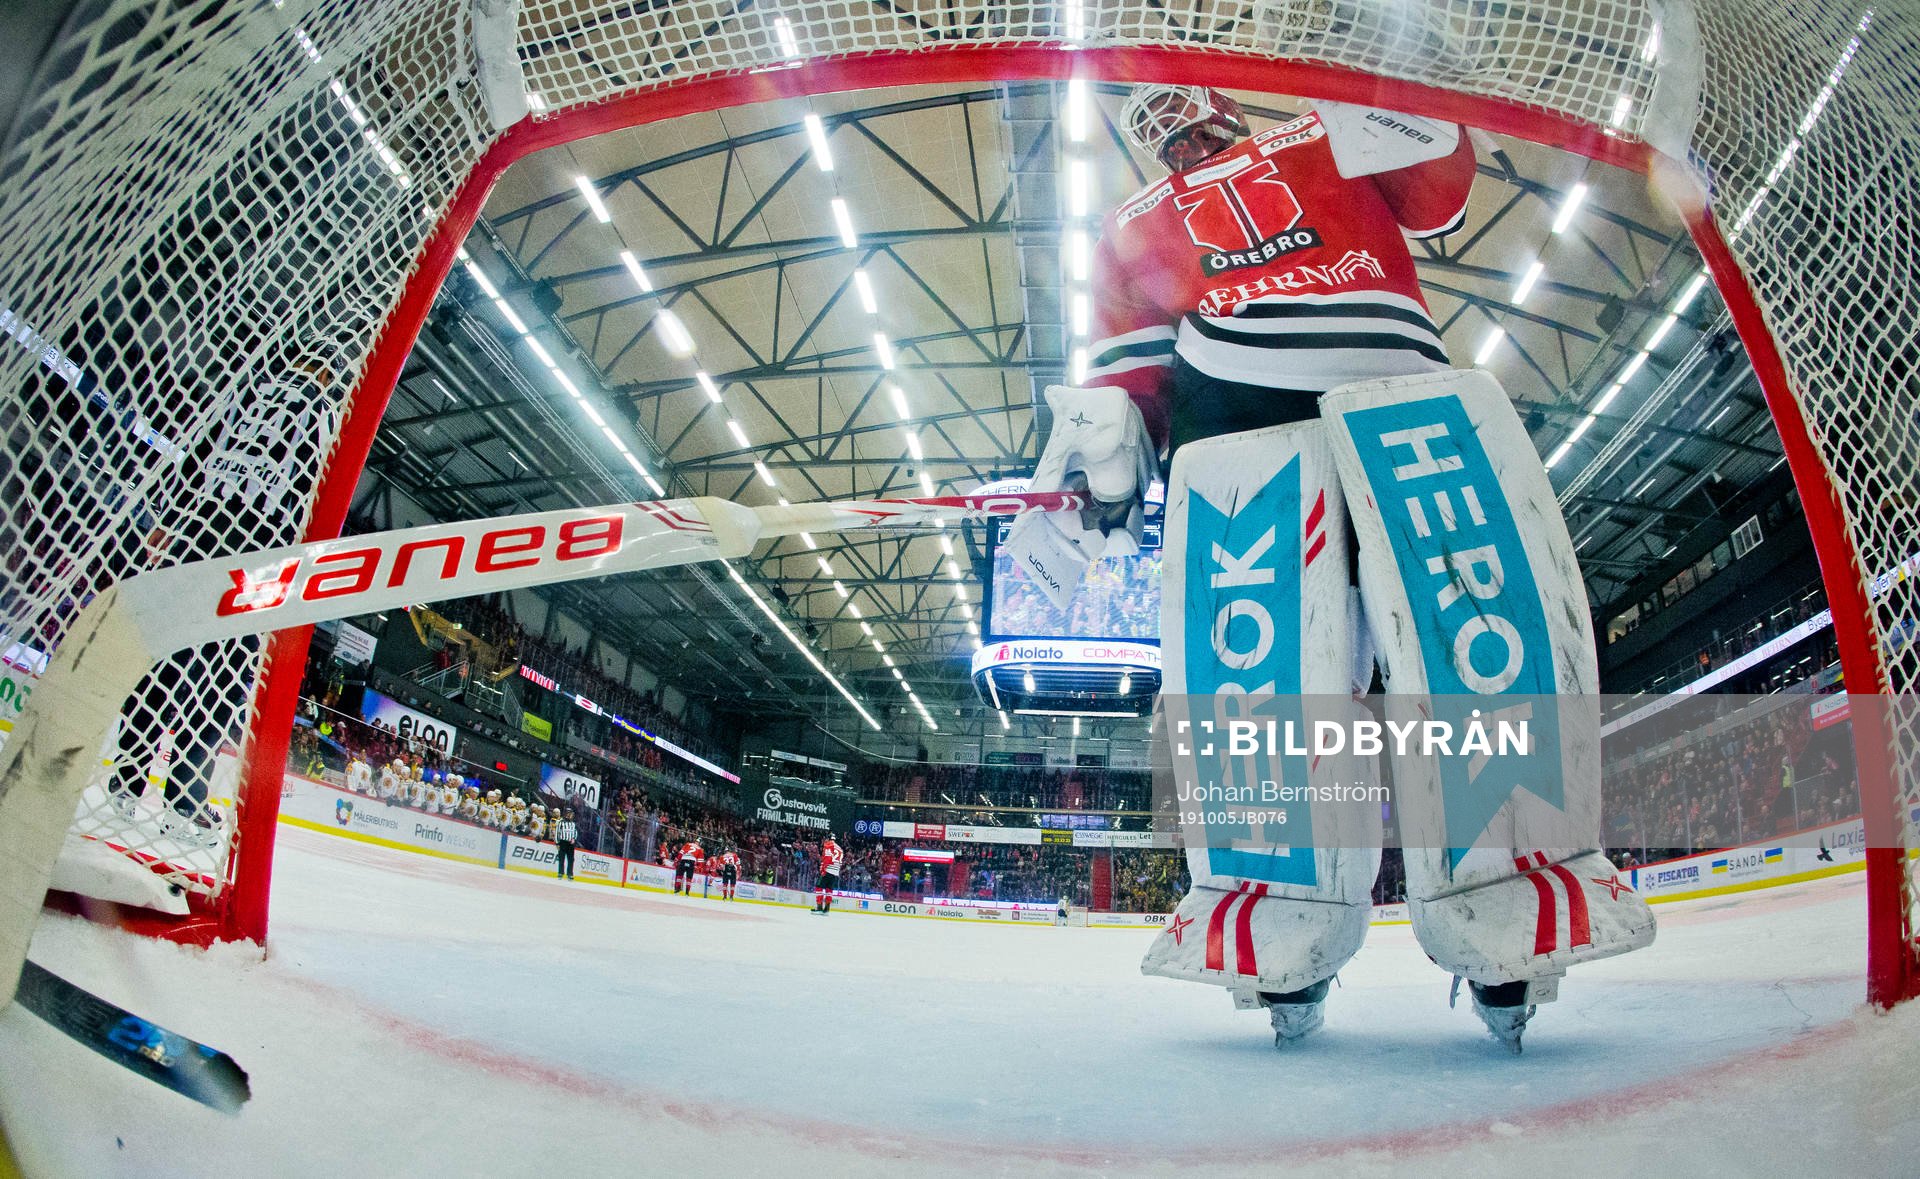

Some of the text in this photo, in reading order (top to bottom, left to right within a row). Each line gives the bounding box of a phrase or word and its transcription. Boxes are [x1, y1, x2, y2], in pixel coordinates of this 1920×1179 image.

[1366, 111, 1434, 145] BAUER
[1210, 231, 1313, 269] ÖREBRO
[216, 513, 626, 617] BAUER
[1028, 551, 1061, 592] VAPOR
[1379, 422, 1535, 786] HEROK
[1013, 647, 1063, 660] Nolato
[1211, 524, 1291, 858] HEROK
[764, 788, 828, 814] Gustavsvik
[757, 808, 830, 830] FAMILJELÄKTARE
[415, 823, 444, 842] Prinfo
[1658, 866, 1699, 883] PISCATOR
[1729, 855, 1764, 870] SANDA
[937, 909, 963, 918] Nolato
